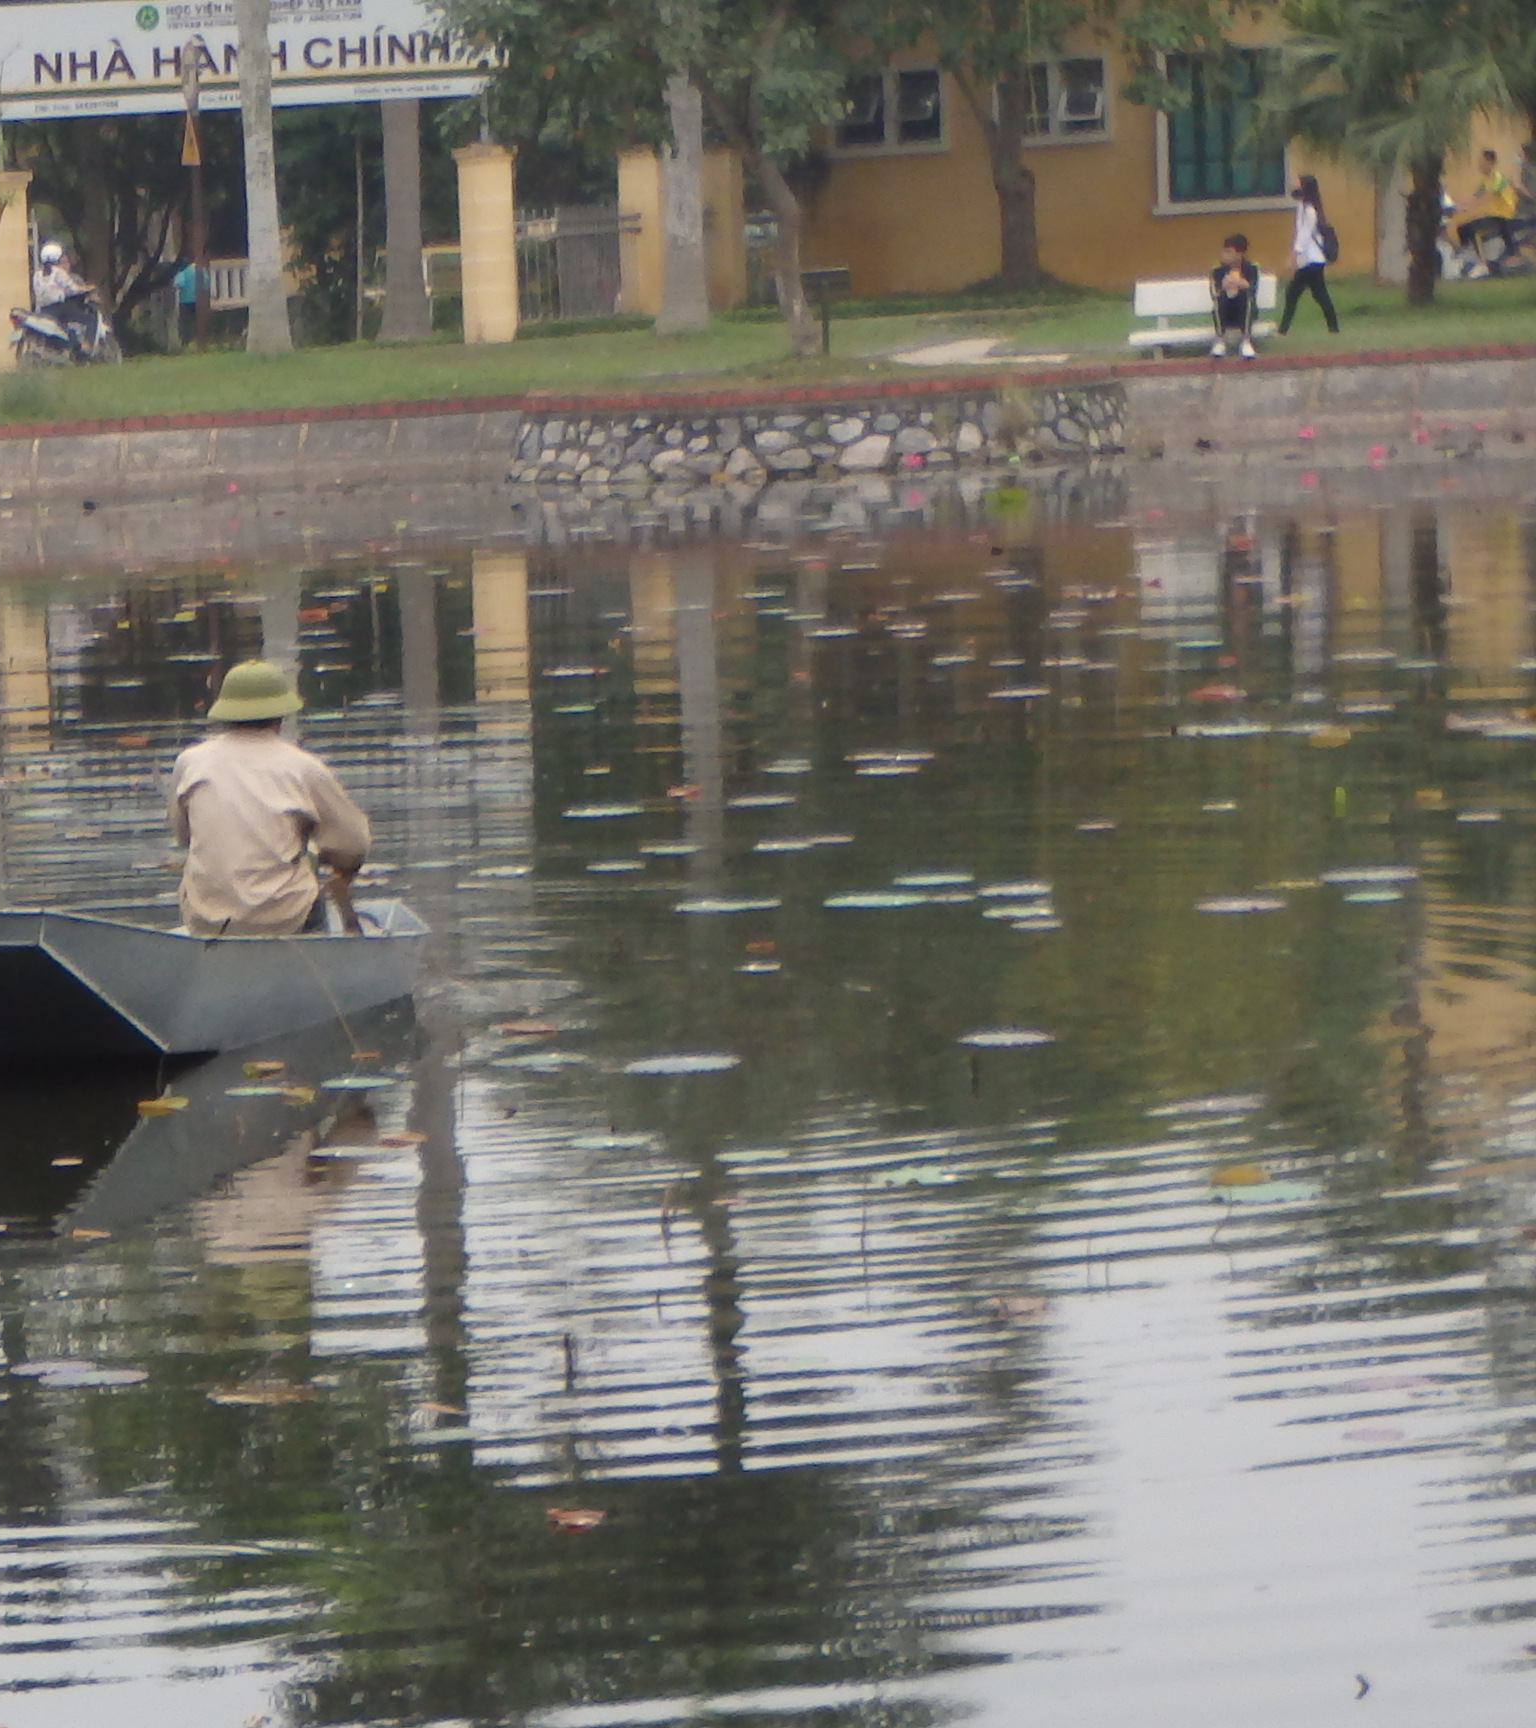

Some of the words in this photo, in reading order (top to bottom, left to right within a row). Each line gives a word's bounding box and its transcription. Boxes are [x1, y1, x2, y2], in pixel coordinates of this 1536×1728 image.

[33, 37, 136, 85] NHÀ
[152, 32, 287, 79] HÀNH
[302, 24, 451, 69] CHÍNH
